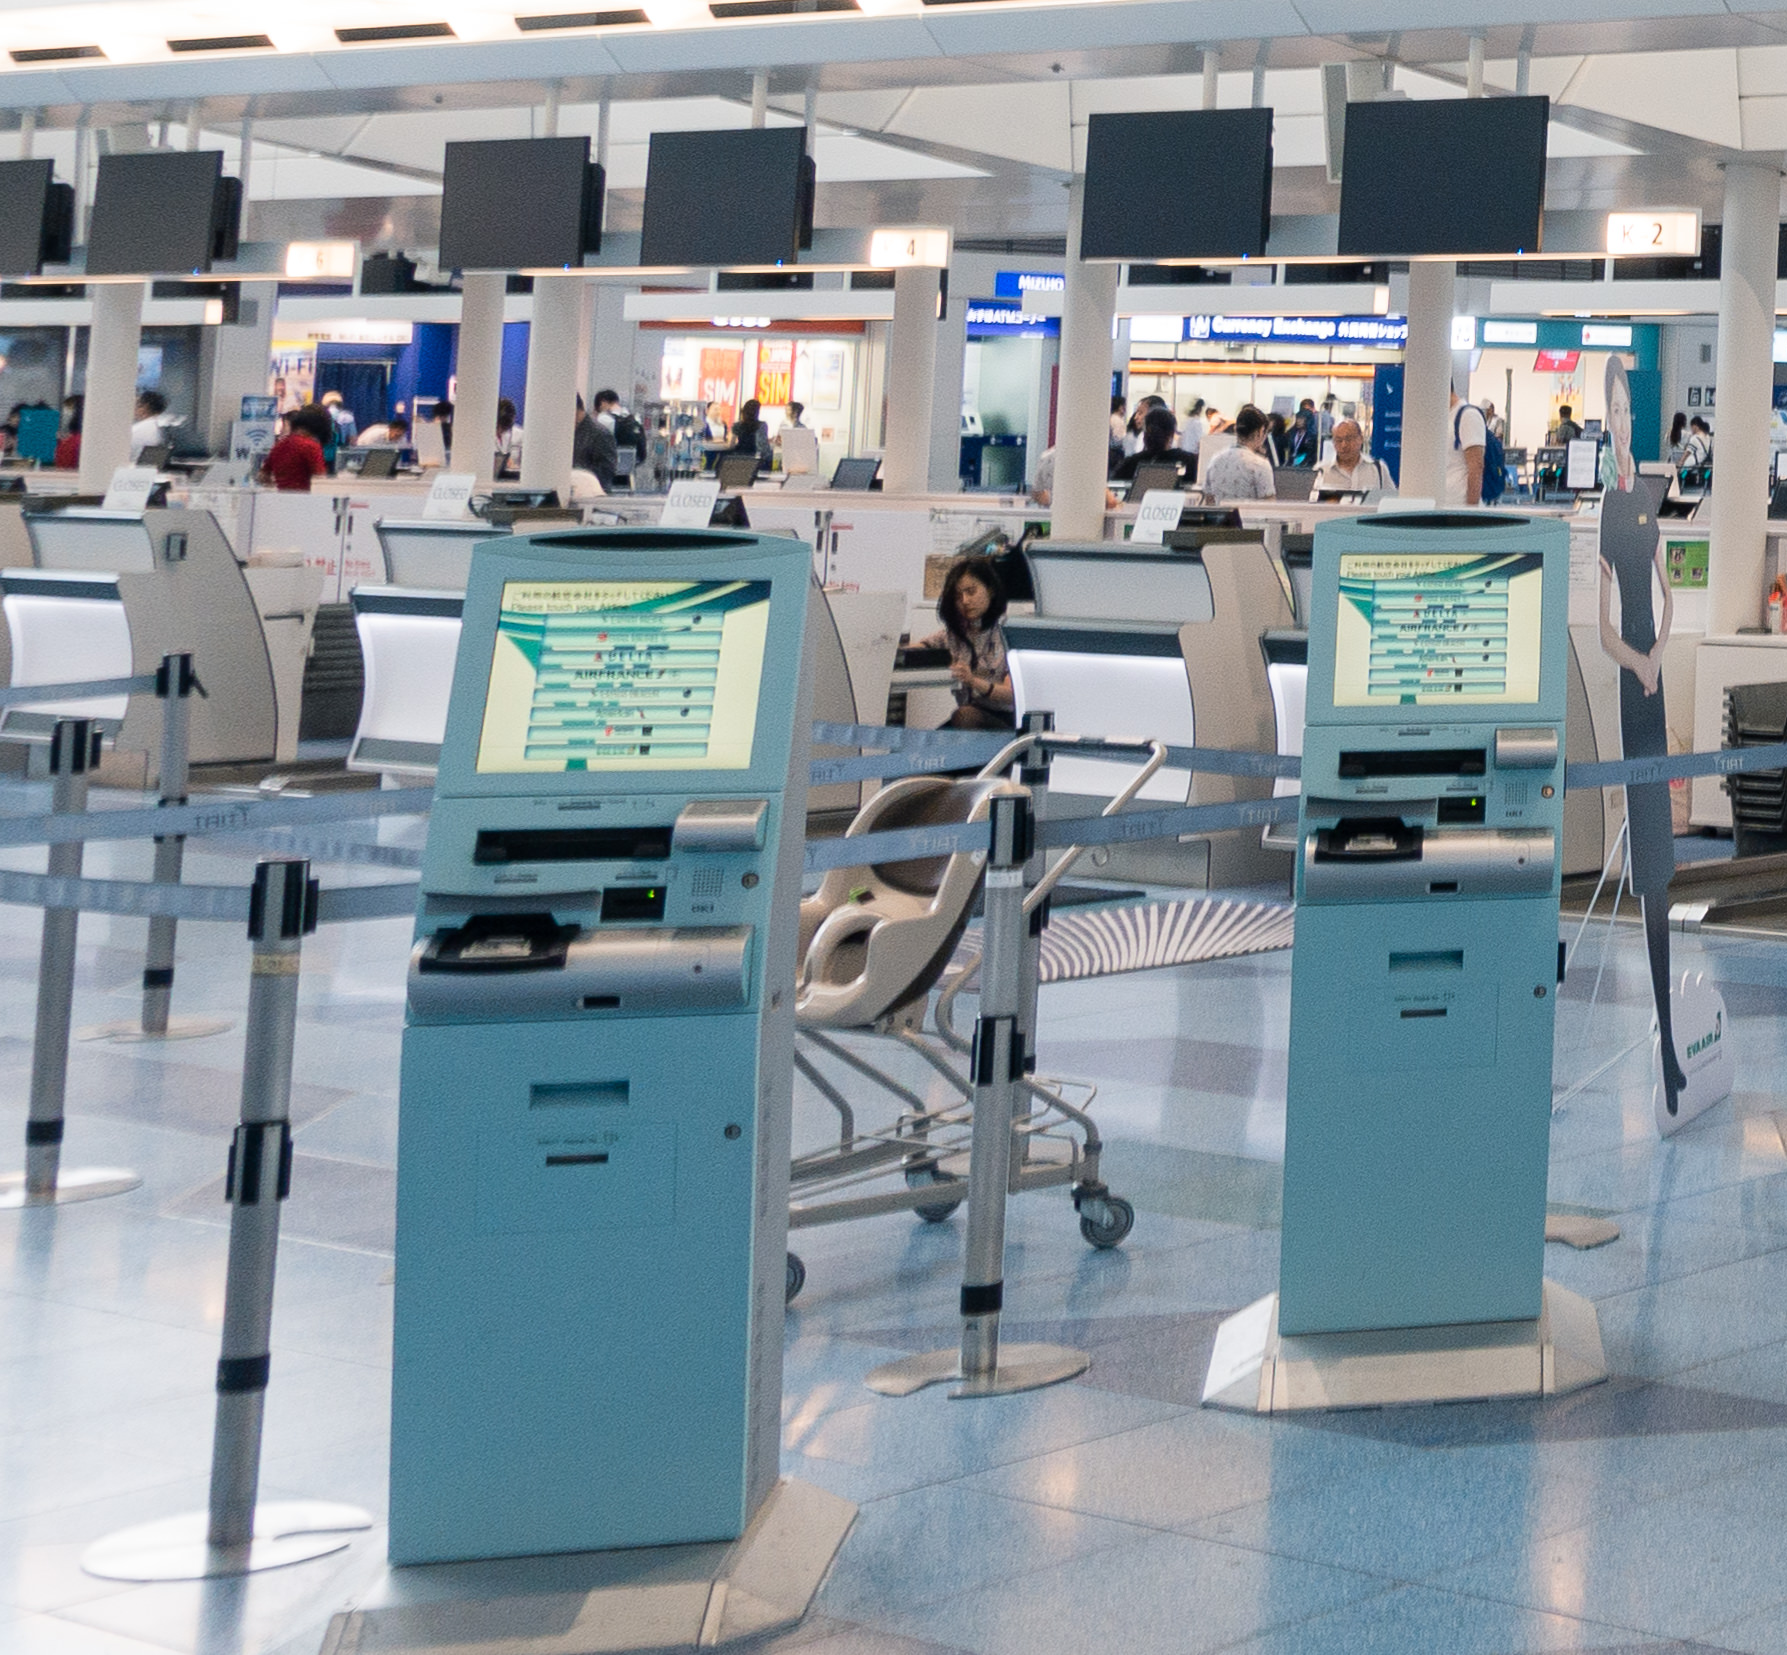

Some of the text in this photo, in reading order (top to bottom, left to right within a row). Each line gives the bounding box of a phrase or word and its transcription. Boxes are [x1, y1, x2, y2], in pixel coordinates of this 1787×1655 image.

[1018, 274, 1064, 290] MIZUHO
[1212, 316, 1272, 337] Currency
[1273, 317, 1336, 339] Exchange
[704, 377, 737, 405] SIM
[758, 372, 791, 405] SIM
[670, 495, 713, 508] CLOSED
[1142, 506, 1178, 521] CLOSED
[1720, 757, 1744, 769] TIAT
